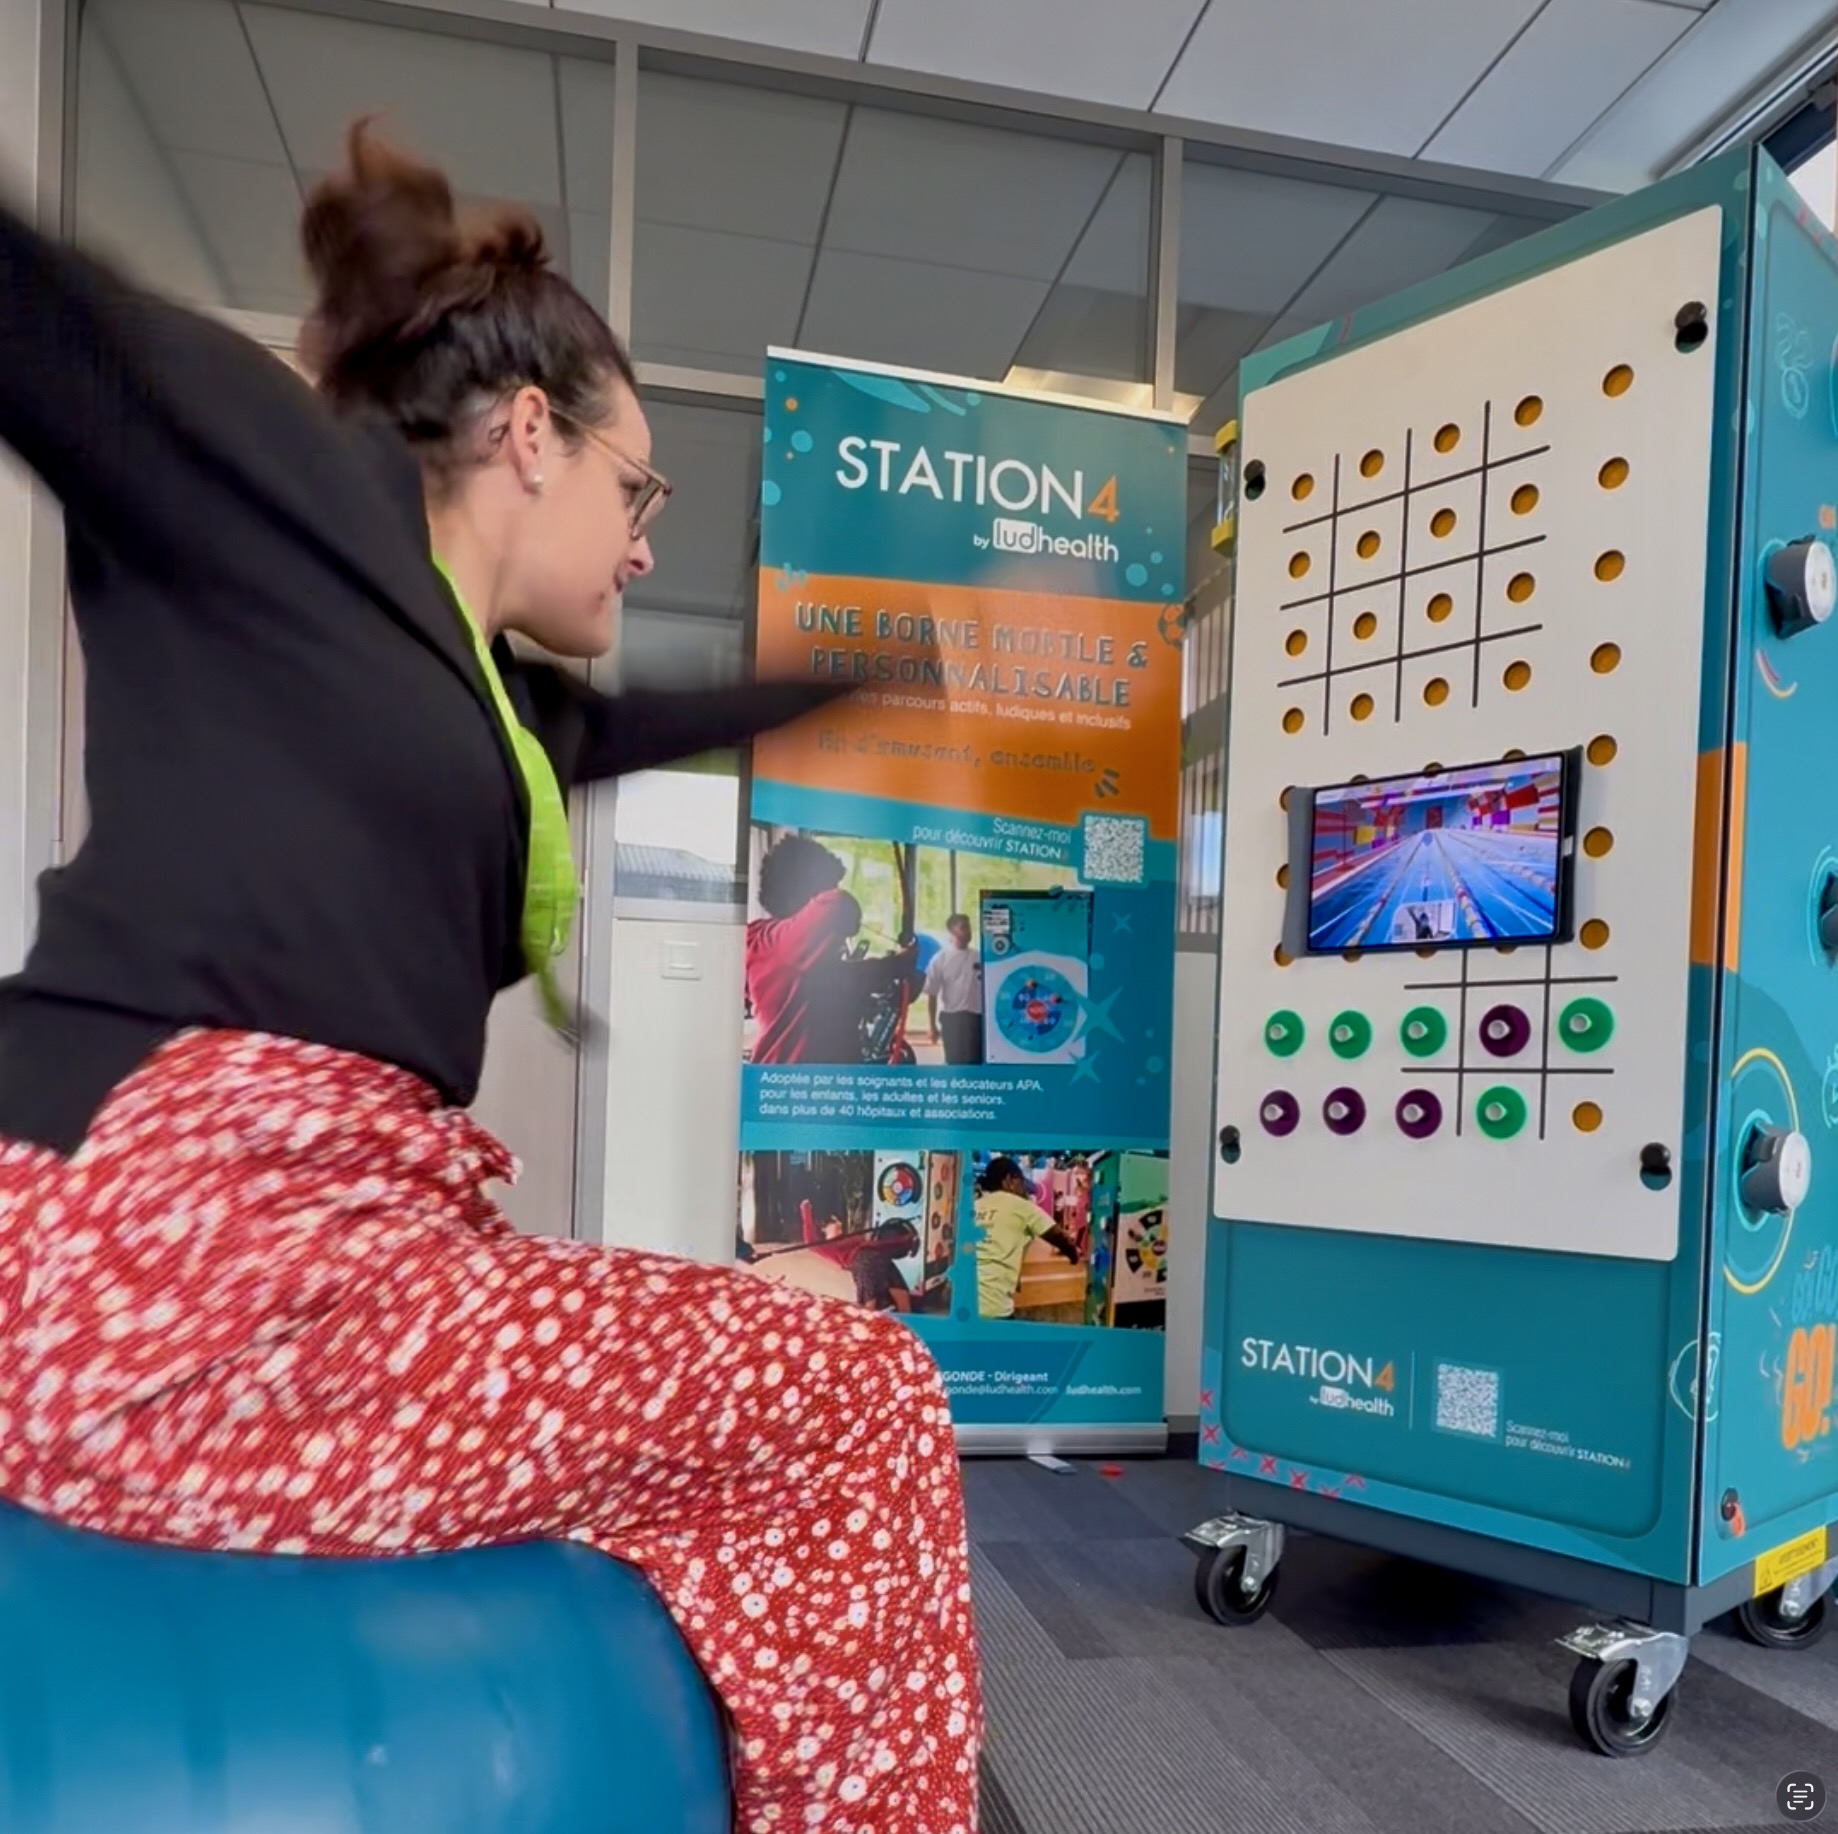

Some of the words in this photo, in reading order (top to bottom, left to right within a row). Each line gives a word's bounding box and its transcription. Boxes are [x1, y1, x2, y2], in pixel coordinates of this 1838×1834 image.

[836, 436, 1119, 523] STATION4
[973, 534, 990, 550] by
[993, 518, 1120, 563] ludhealth
[794, 601, 862, 637] UNE
[876, 608, 979, 649] BORNE
[1127, 641, 1149, 669] &
[811, 646, 1131, 707] PERSONNALISABLE
[881, 693, 945, 711] parcours
[996, 703, 1055, 724] ludiques
[1059, 711, 1073, 723] et
[1077, 712, 1131, 730] inclusifs
[912, 825, 942, 842] pour
[944, 826, 1002, 851] découvrir
[993, 817, 1072, 844] Scannez-moi
[761, 1071, 810, 1086] Adoptée
[813, 1074, 833, 1087] par
[836, 1073, 854, 1085] les
[857, 1076, 913, 1089] soignants
[916, 1077, 928, 1088] et
[930, 1076, 947, 1089] les
[950, 1078, 1013, 1091] éducateurs
[1016, 1079, 1044, 1092] APA,
[760, 1088, 788, 1101] pour
[790, 1087, 808, 1100] les
[810, 1089, 858, 1102] enfants,
[861, 1090, 879, 1102] les
[881, 1091, 924, 1102] adultes
[927, 1092, 939, 1103] et
[942, 1092, 958, 1104] les
[759, 1102, 789, 1115] dans
[791, 1103, 817, 1117] plus
[820, 1103, 836, 1116] de
[839, 1104, 854, 1116] 40
[857, 1103, 907, 1119] hôpitaux
[909, 1107, 921, 1118] et
[942, 1370, 986, 1383] GONDE
[994, 1370, 1049, 1385] Dirigeant
[946, 1383, 1059, 1395] gonde@ludhealth.com
[1066, 1384, 1141, 1397] ludhealth.com
[1781, 1321, 1836, 1450] GO!
[1505, 1434, 1527, 1448] pour
